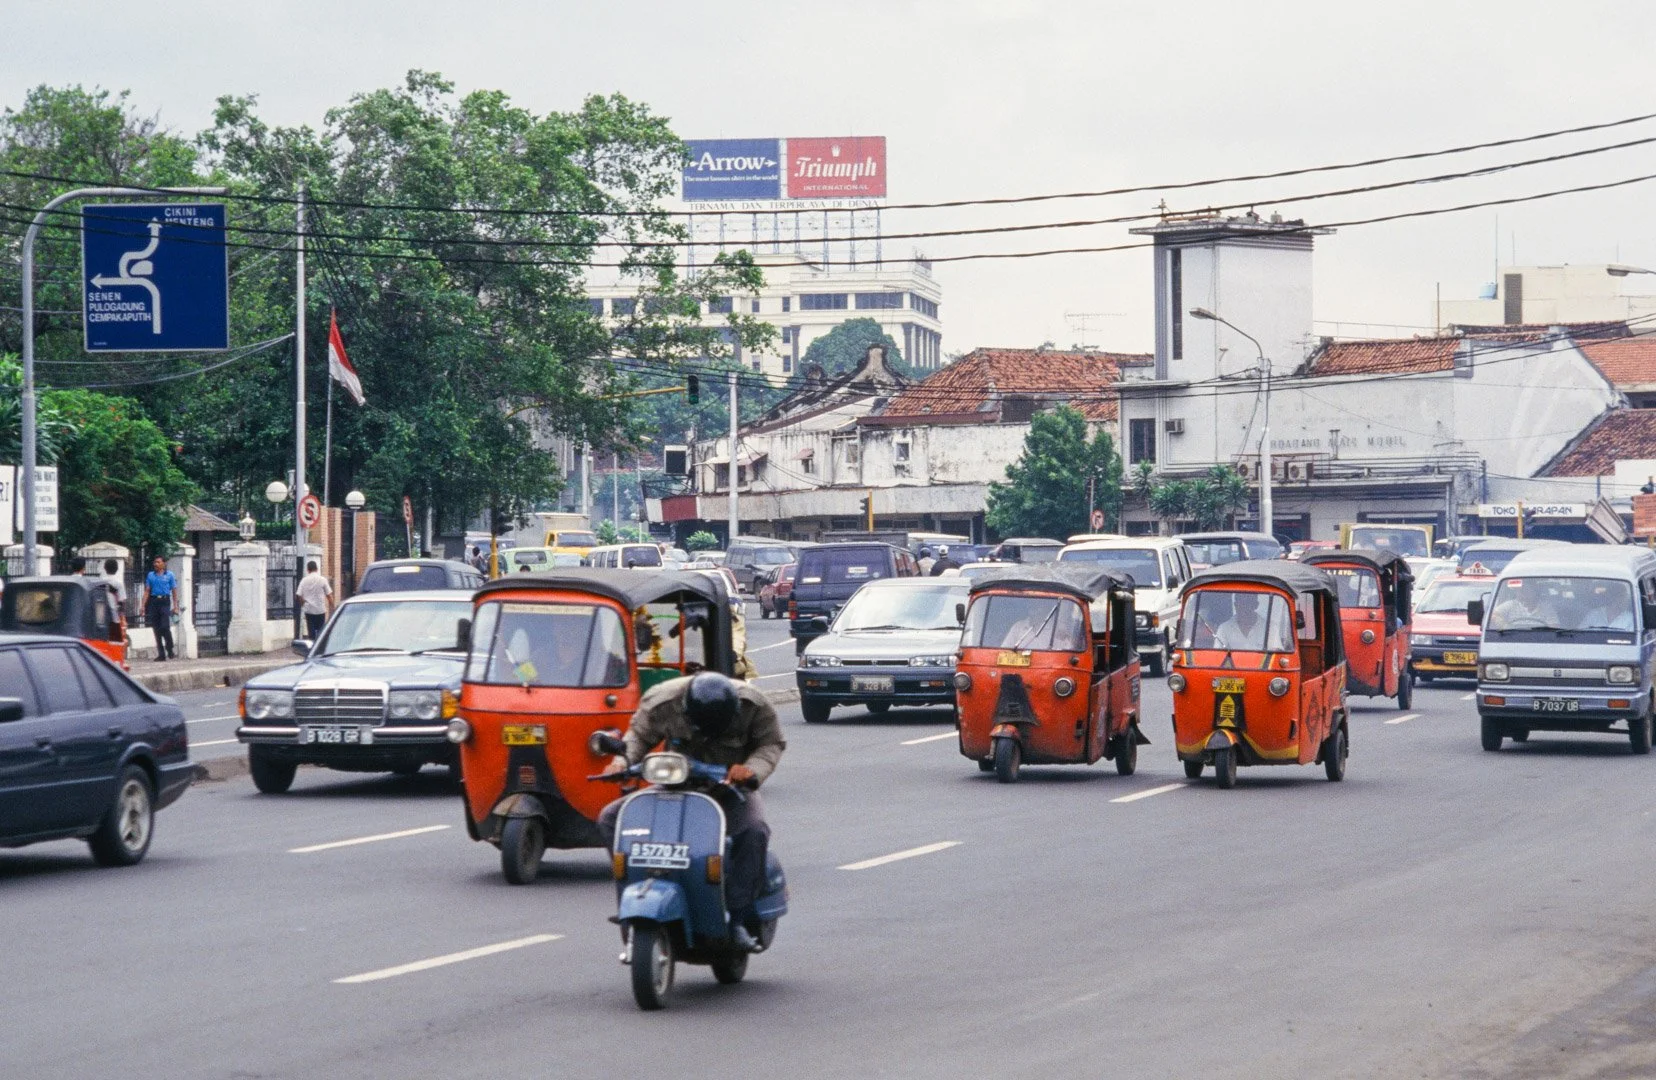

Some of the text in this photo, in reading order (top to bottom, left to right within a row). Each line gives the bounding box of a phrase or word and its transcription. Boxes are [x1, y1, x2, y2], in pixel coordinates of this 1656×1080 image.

[698, 151, 765, 171] Arrow
[794, 156, 877, 181] Triumph
[164, 207, 196, 217] CIKINI
[690, 203, 735, 211] TERNAMA
[88, 292, 121, 302] SENEN
[89, 302, 145, 312] PULOGADUNG
[88, 312, 151, 323] CEMPAKAPUTIH
[1492, 506, 1572, 515] TOKO ARAPAN
[1533, 700, 1540, 710] B
[1541, 700, 1566, 711] 7037
